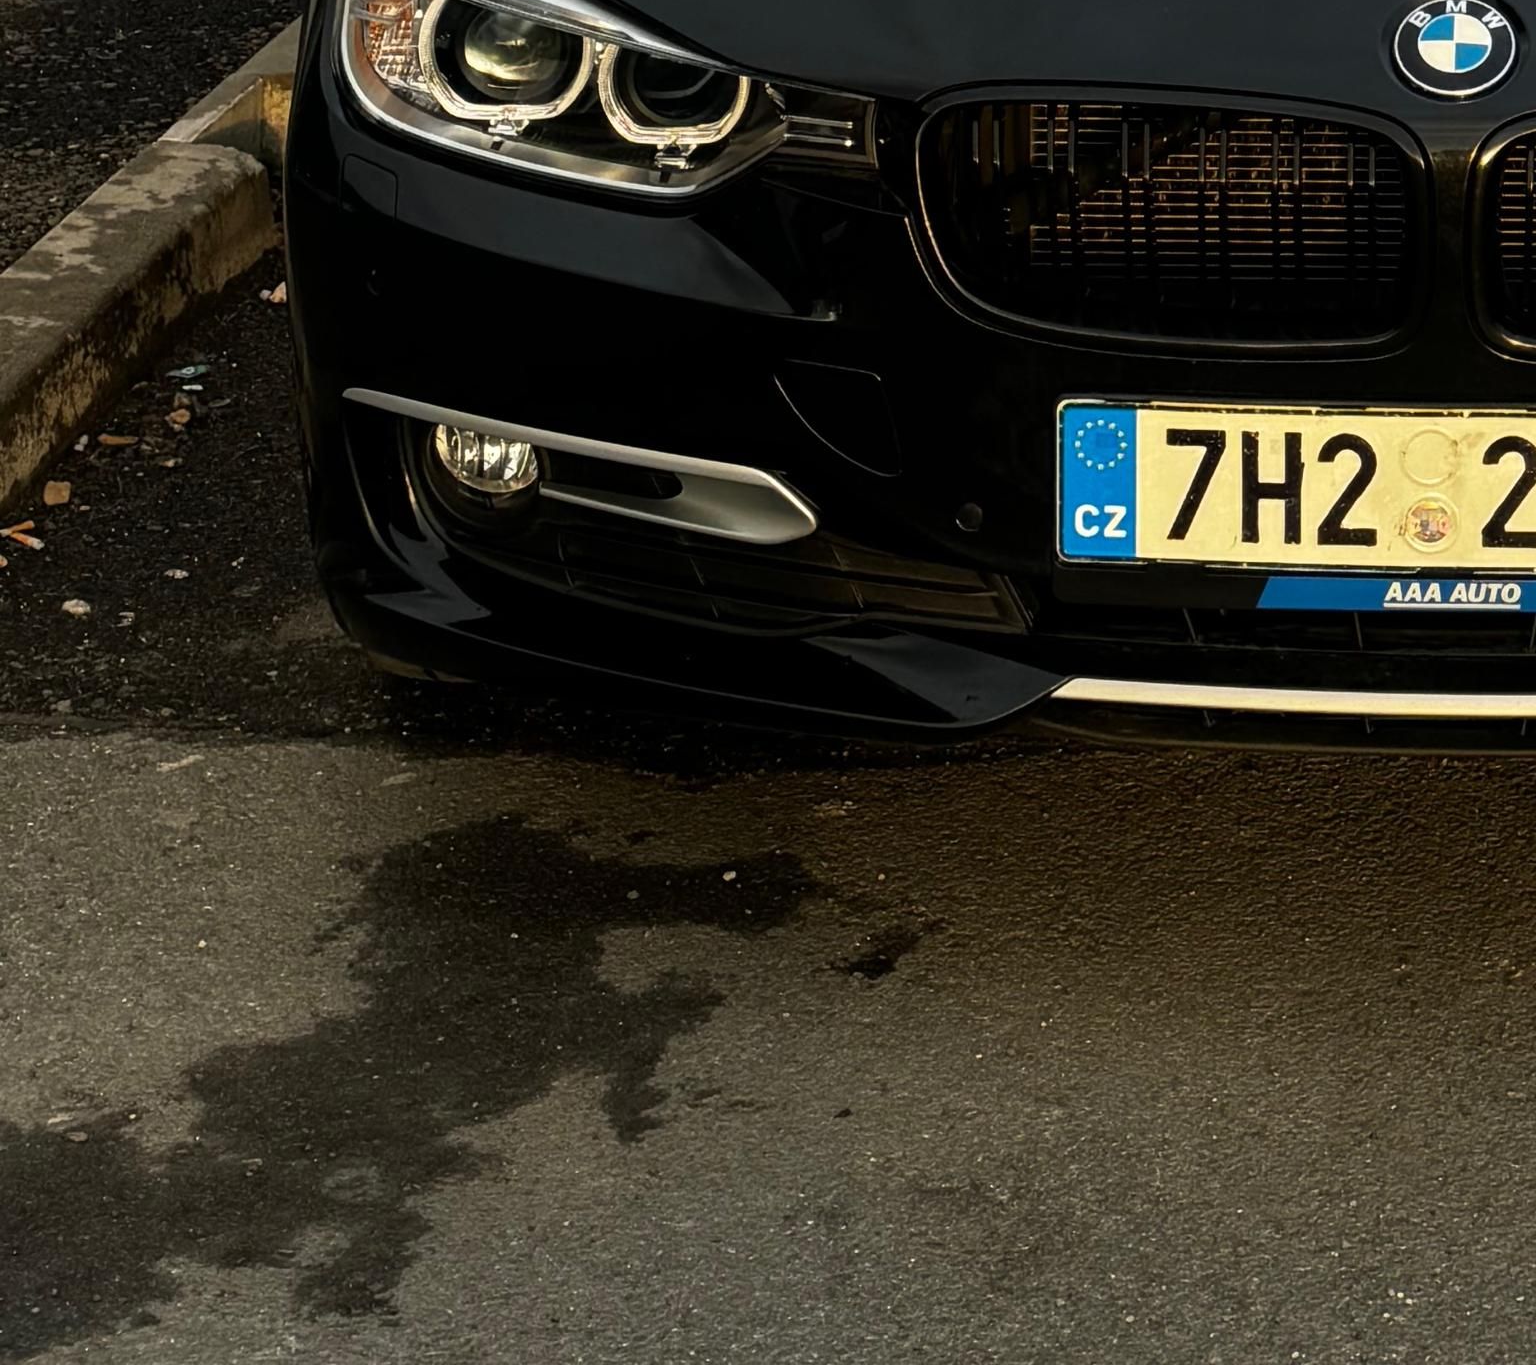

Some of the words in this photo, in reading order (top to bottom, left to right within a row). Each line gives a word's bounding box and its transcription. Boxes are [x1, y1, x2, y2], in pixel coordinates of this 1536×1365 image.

[1165, 427, 1378, 548] 7H2
[1074, 504, 1128, 538] CZ
[1384, 581, 1442, 603] AAA
[1449, 581, 1522, 604] AUTO
